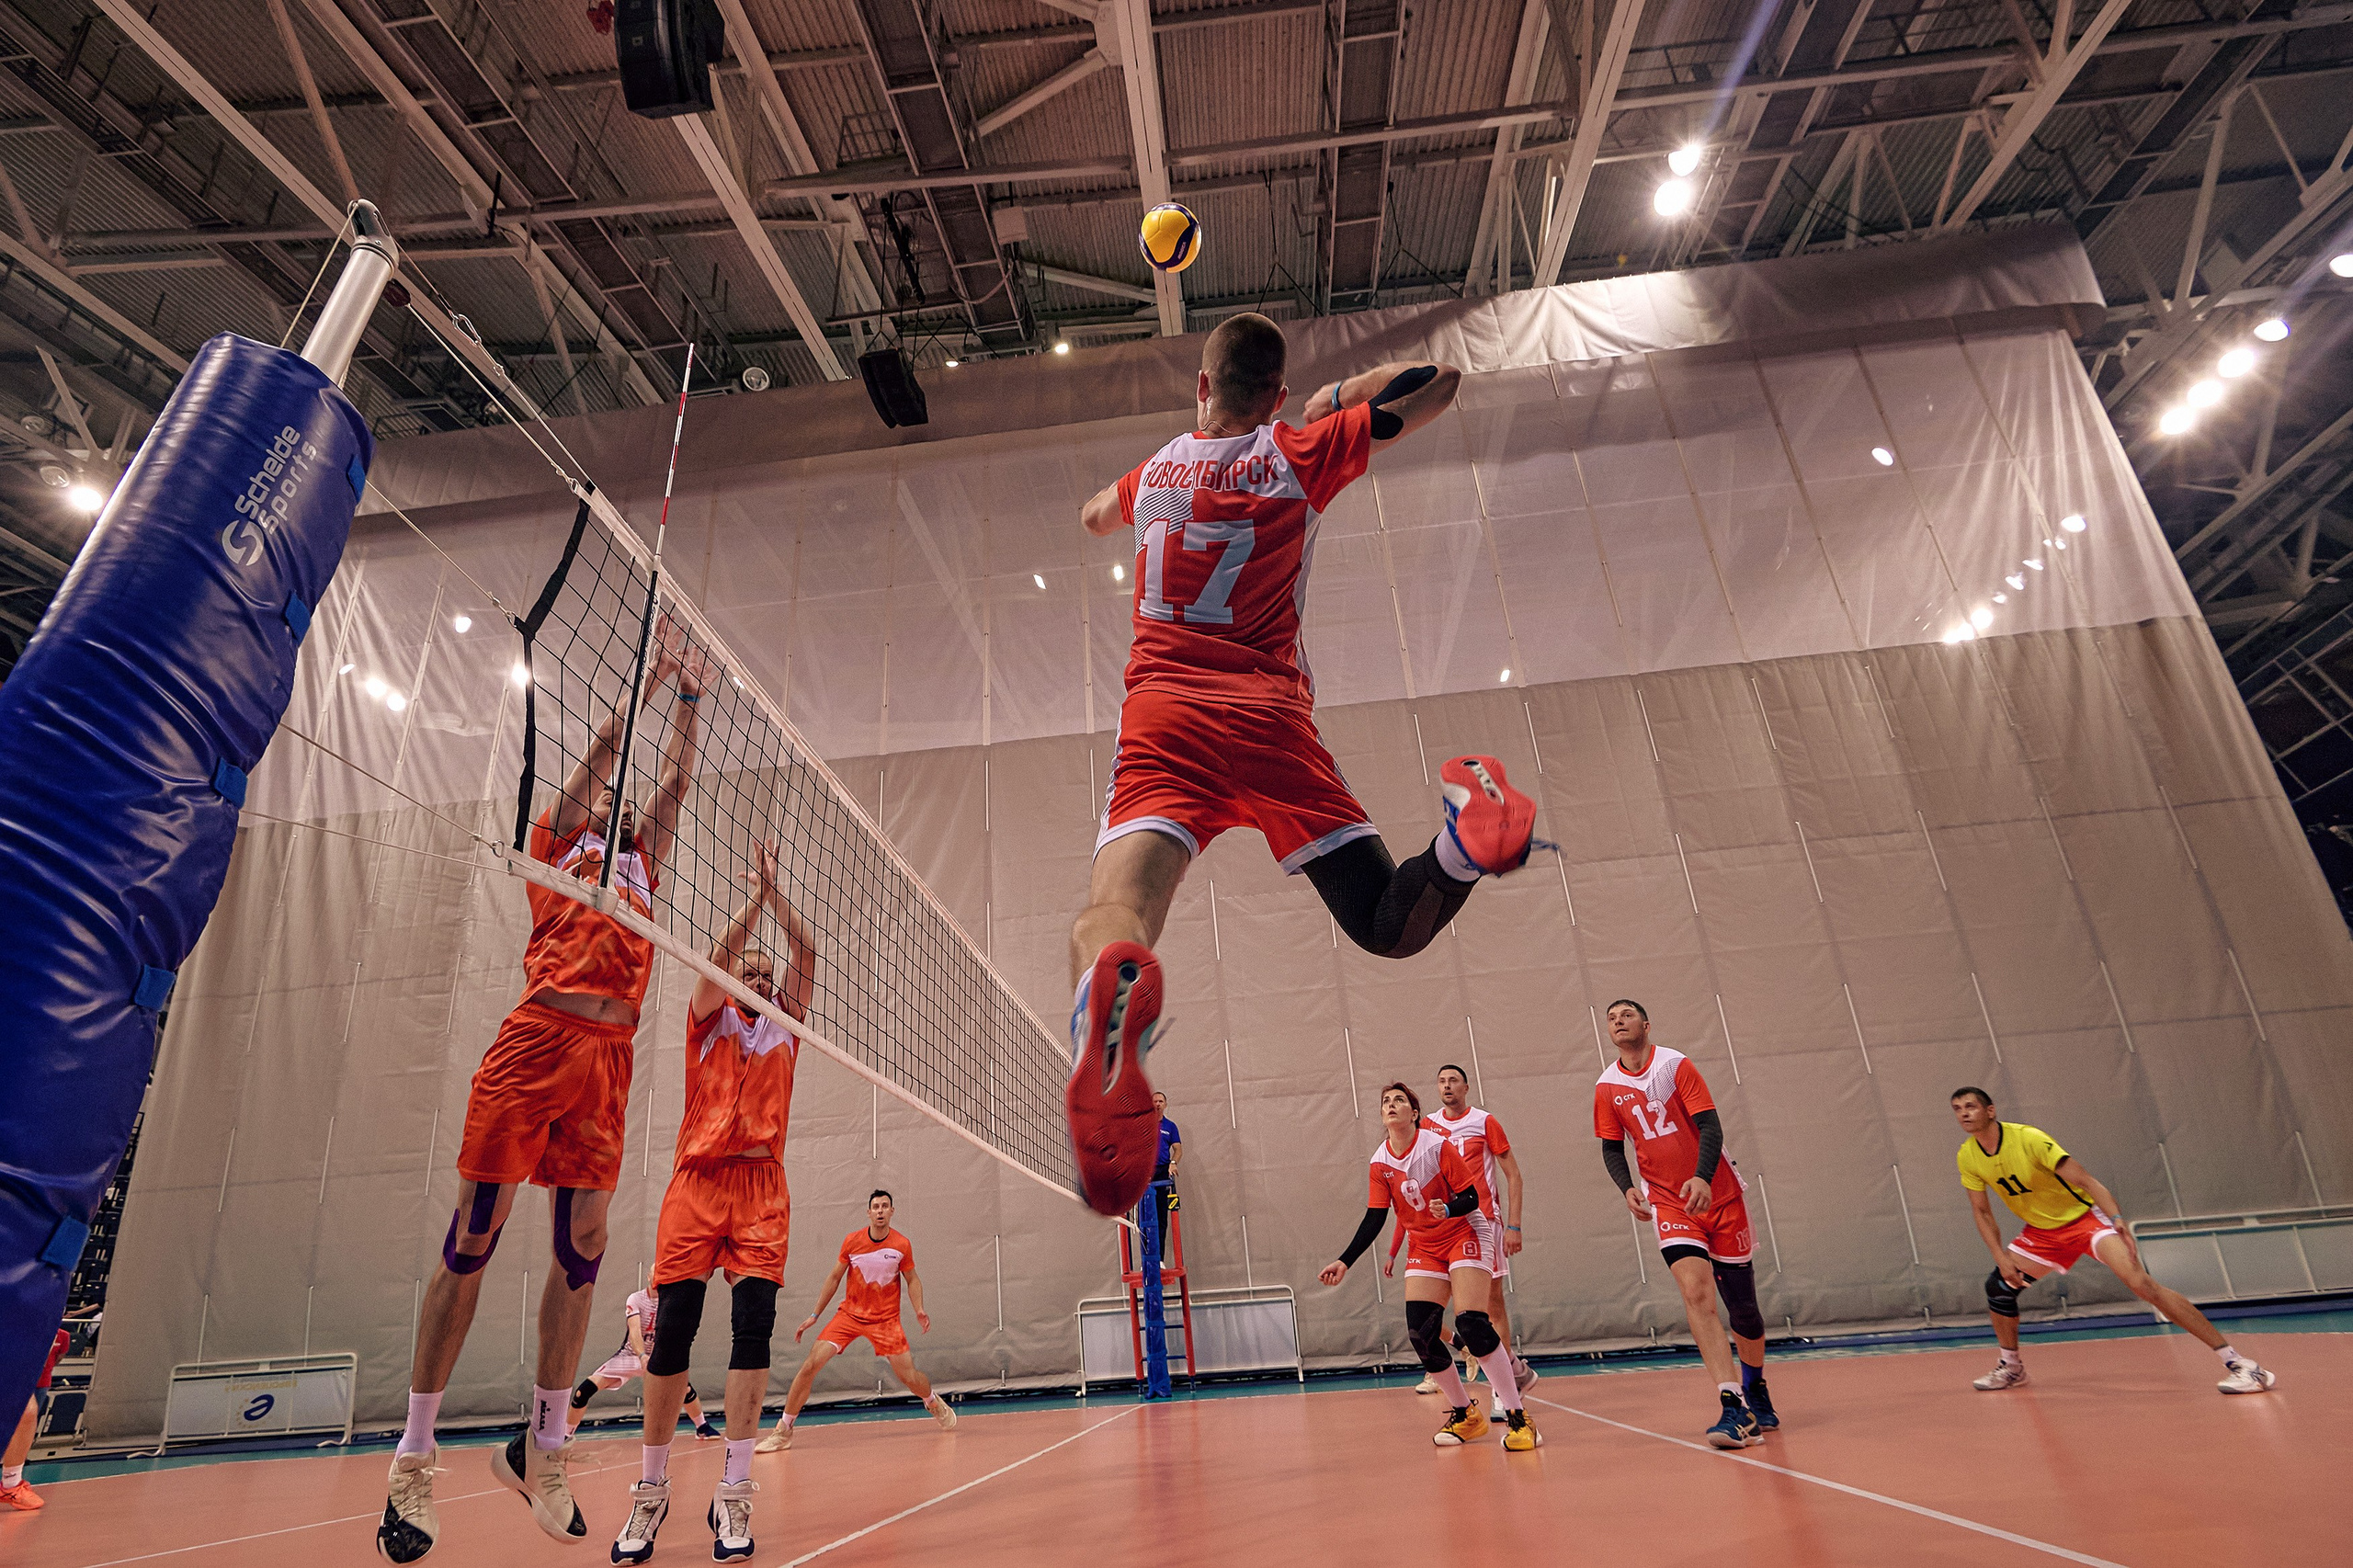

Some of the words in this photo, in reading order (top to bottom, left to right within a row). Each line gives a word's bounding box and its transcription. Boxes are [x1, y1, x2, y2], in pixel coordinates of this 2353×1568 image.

[235, 426, 301, 519] Schelde
[257, 441, 317, 535] Sports
[1139, 518, 1256, 625] 17
[1631, 1099, 1678, 1141] 12
[1401, 1178, 1426, 1211] 8
[1996, 1174, 2032, 1196] 11
[1672, 1222, 1690, 1231] СГК
[1463, 1241, 1478, 1256] 8
